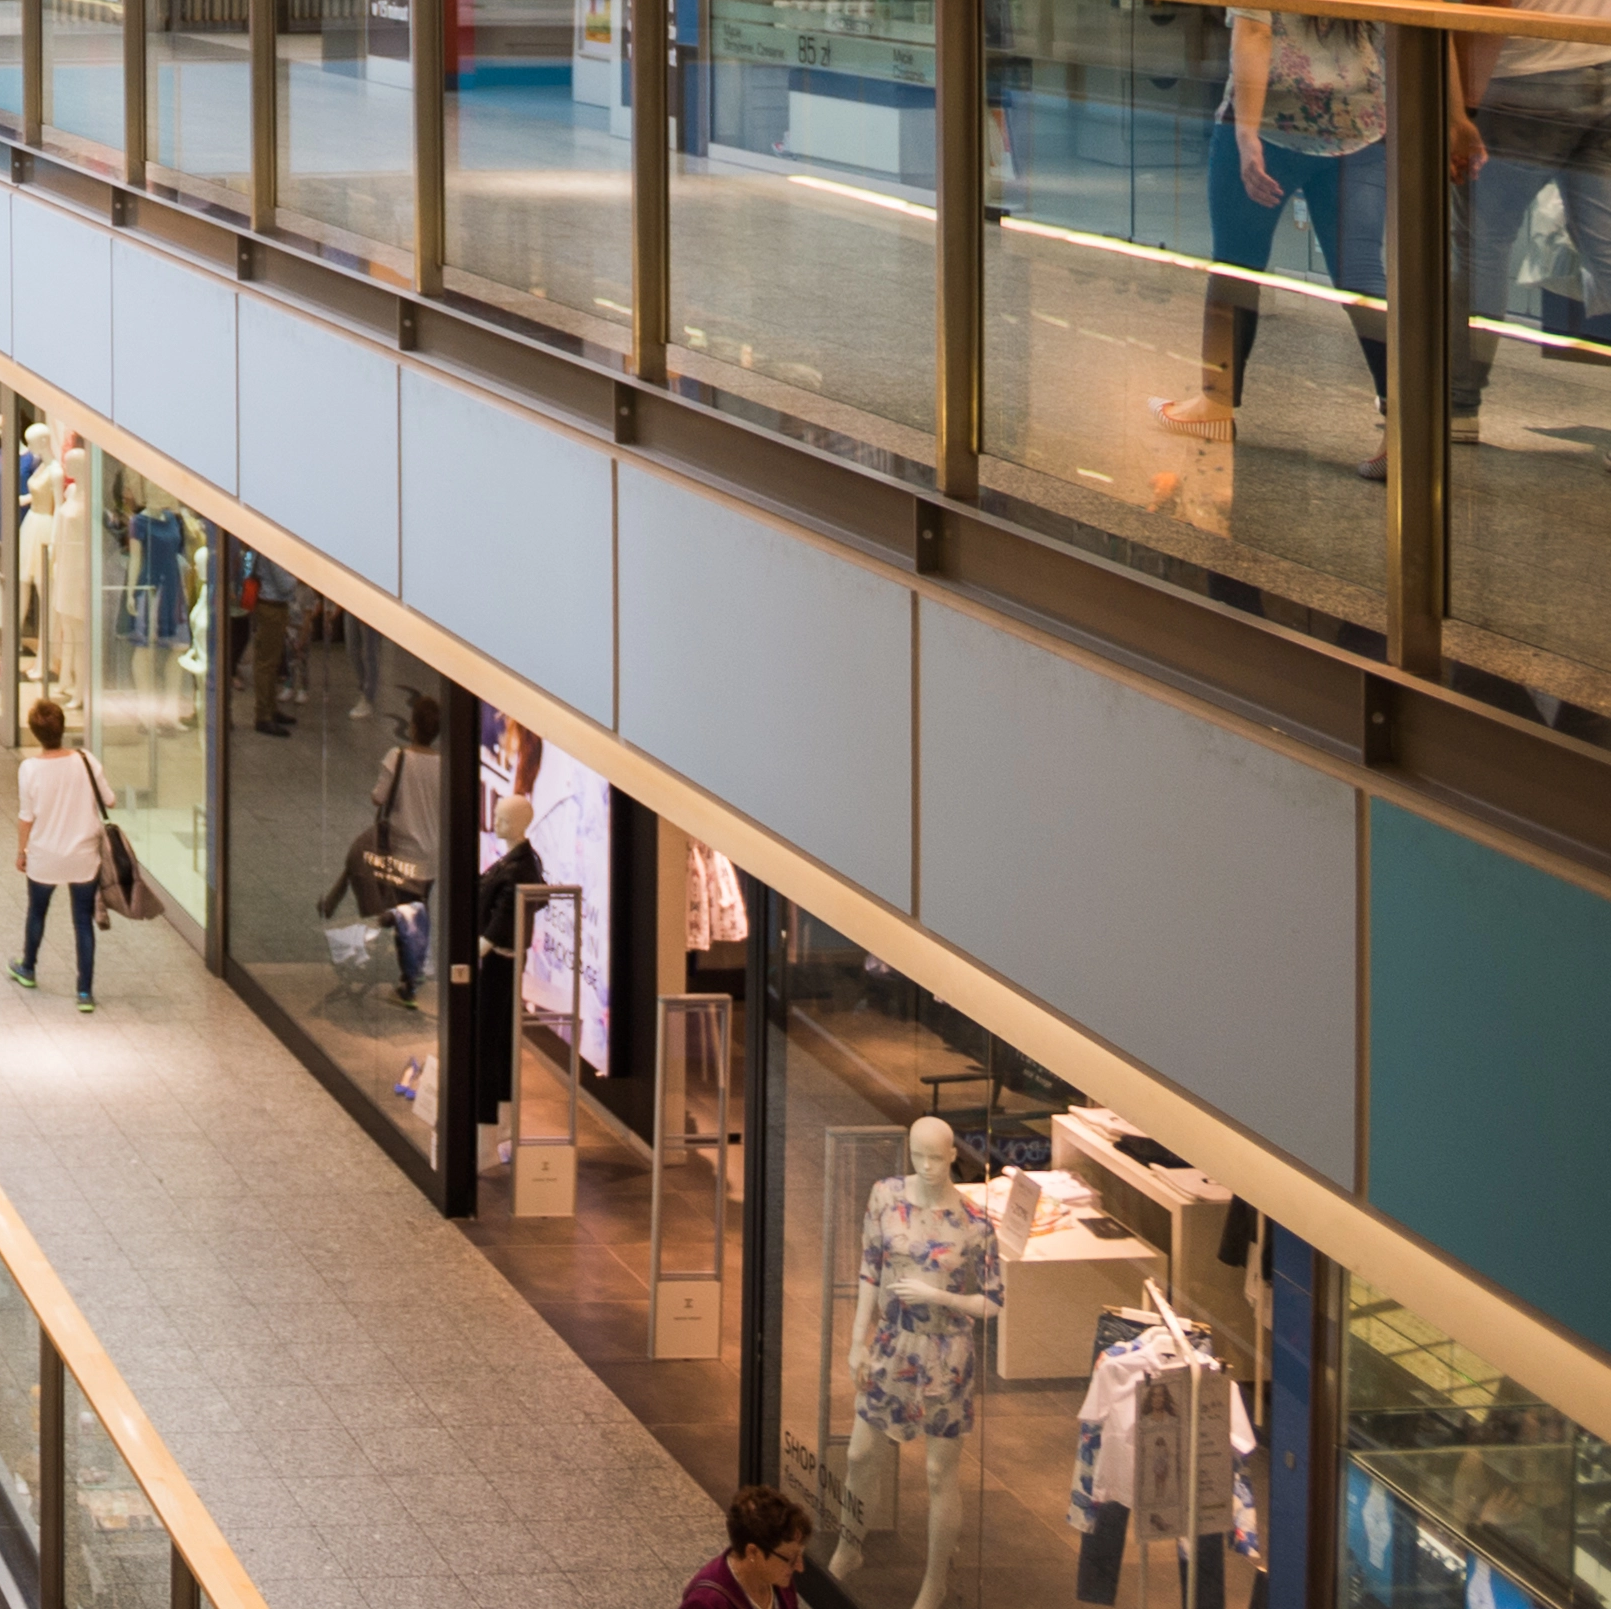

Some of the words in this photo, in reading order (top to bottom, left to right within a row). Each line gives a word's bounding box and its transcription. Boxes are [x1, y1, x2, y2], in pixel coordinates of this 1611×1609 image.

[798, 35, 817, 64] 85
[820, 47, 831, 67] zł
[784, 1431, 816, 1475] SHOP
